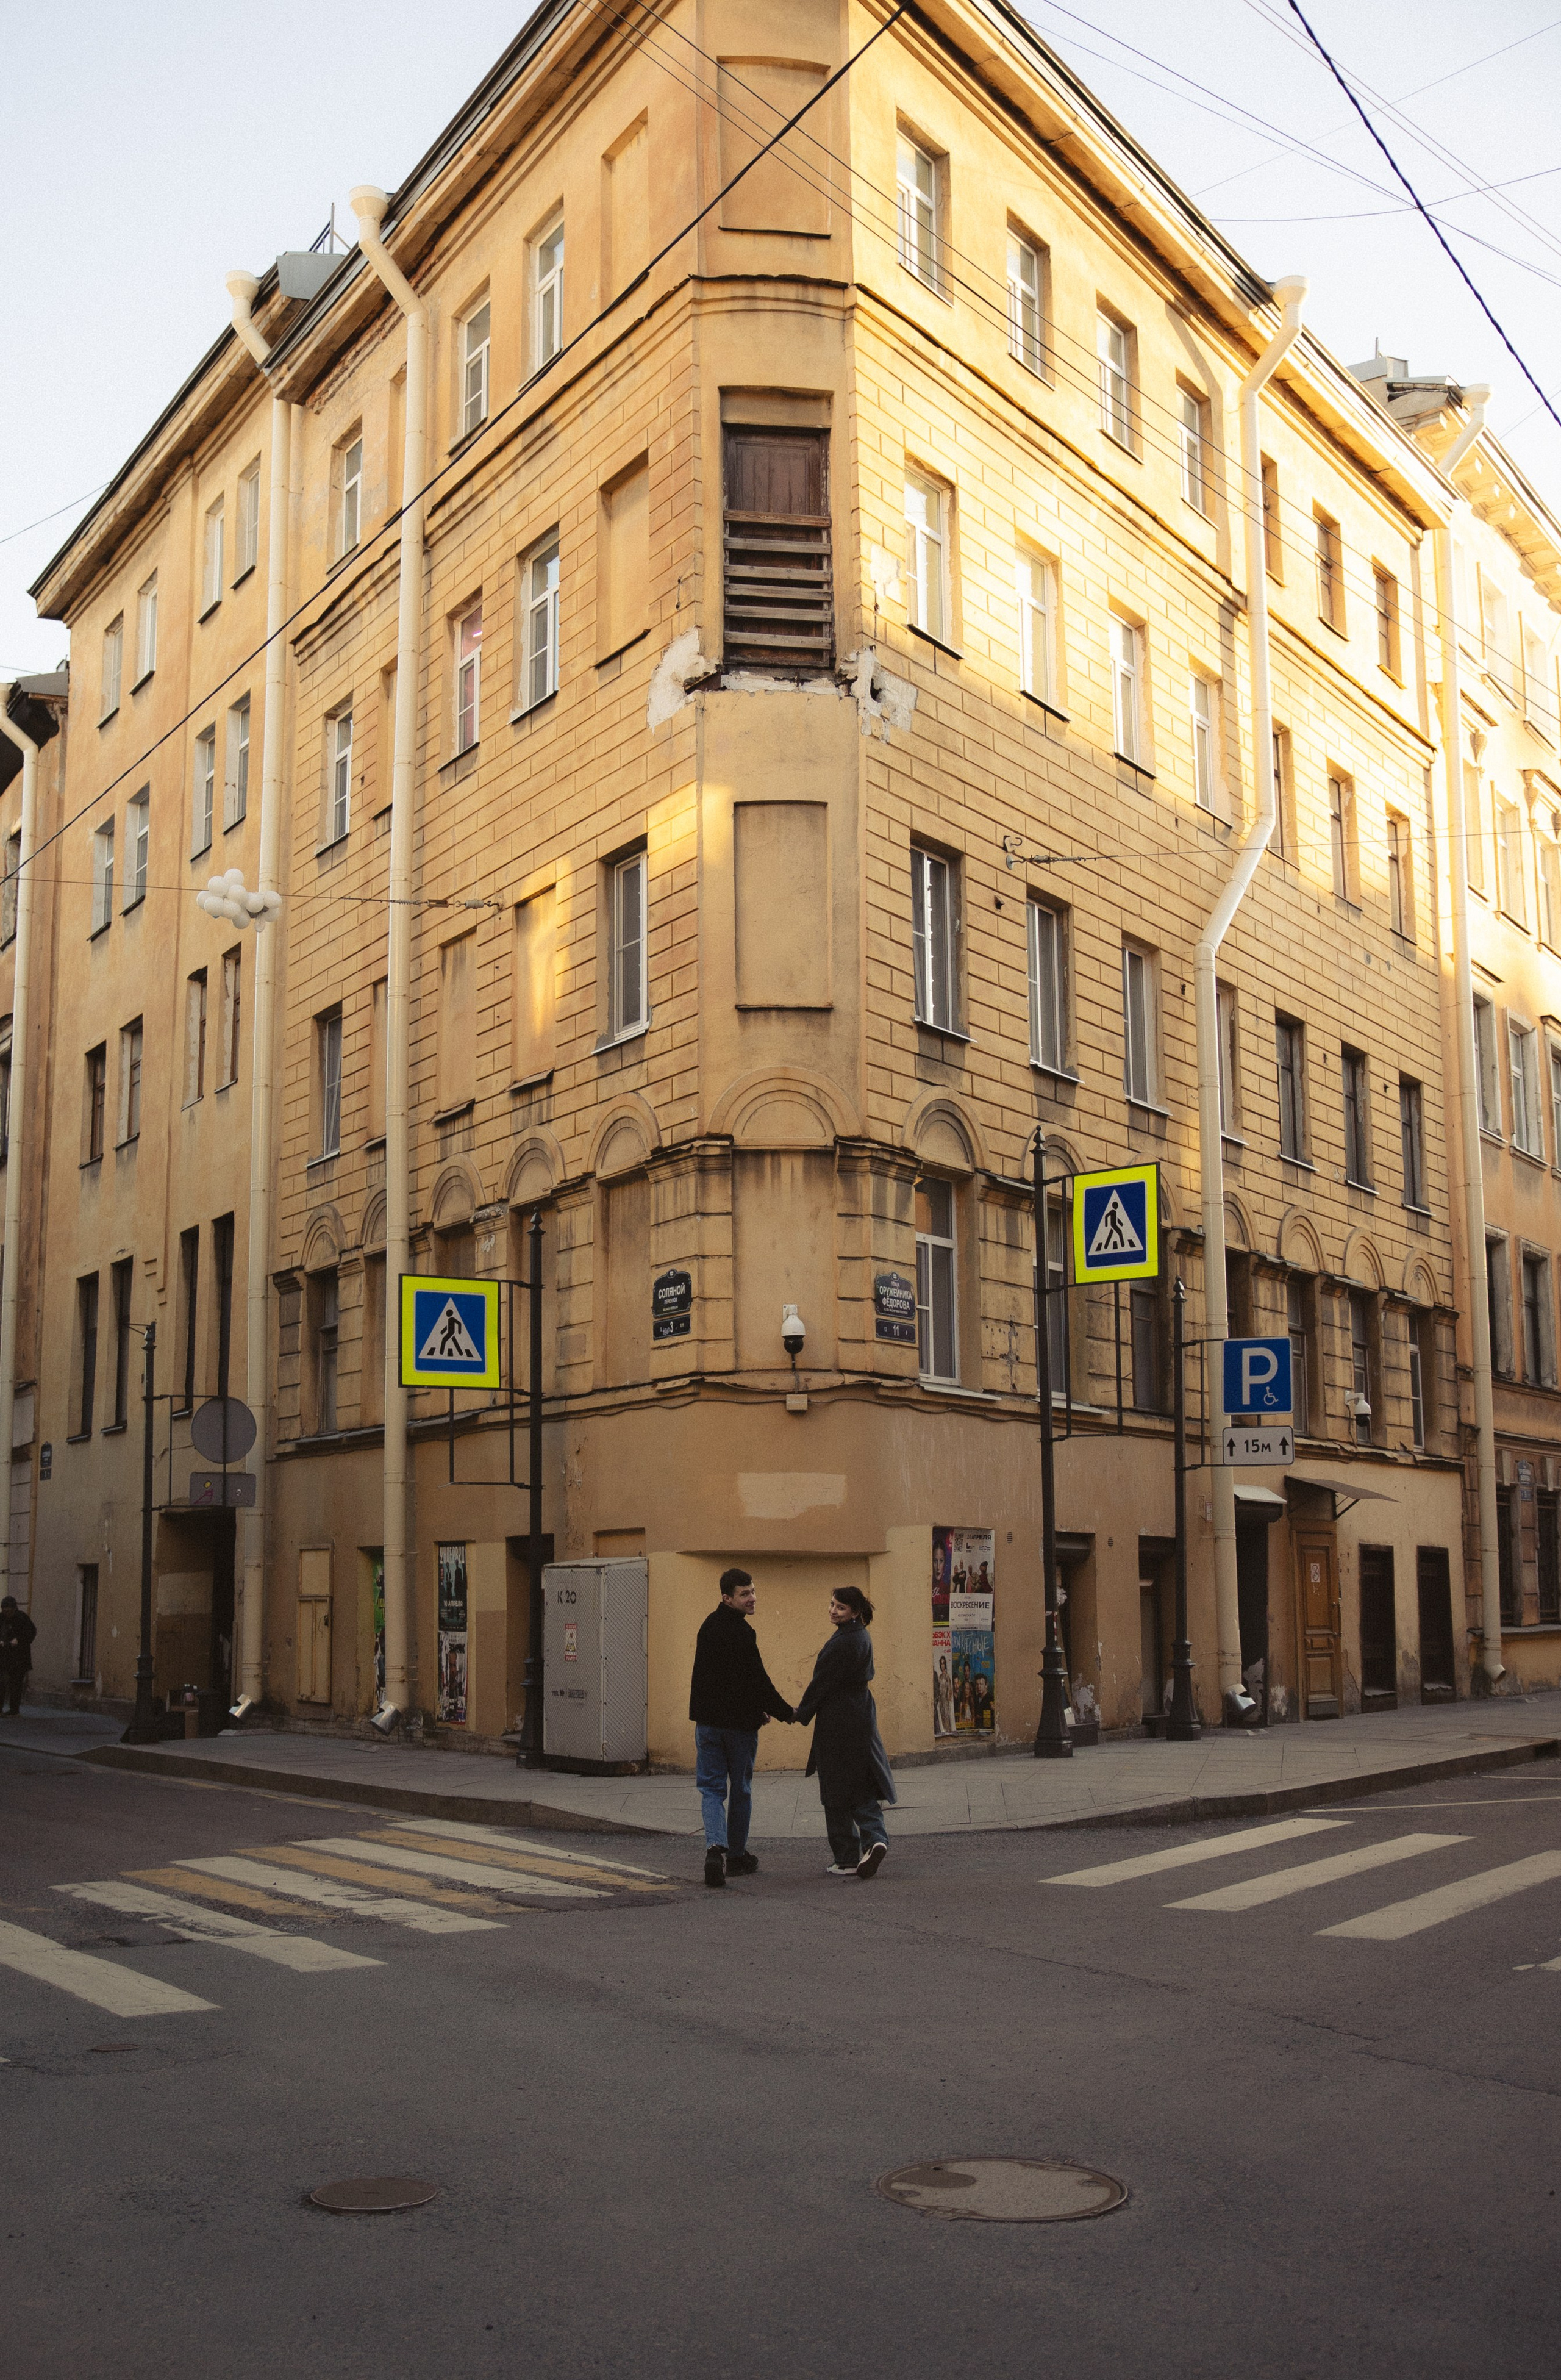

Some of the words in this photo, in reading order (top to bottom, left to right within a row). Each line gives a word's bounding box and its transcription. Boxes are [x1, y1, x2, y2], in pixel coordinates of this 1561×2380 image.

[659, 1283, 685, 1299] СОЛЯНОЙ
[879, 1286, 912, 1300] ОРУЖЕЙНИКА
[882, 1296, 910, 1310] ФЁДОРОВА
[670, 1321, 674, 1333] 3
[893, 1324, 899, 1336] 11
[1242, 1347, 1279, 1405] P
